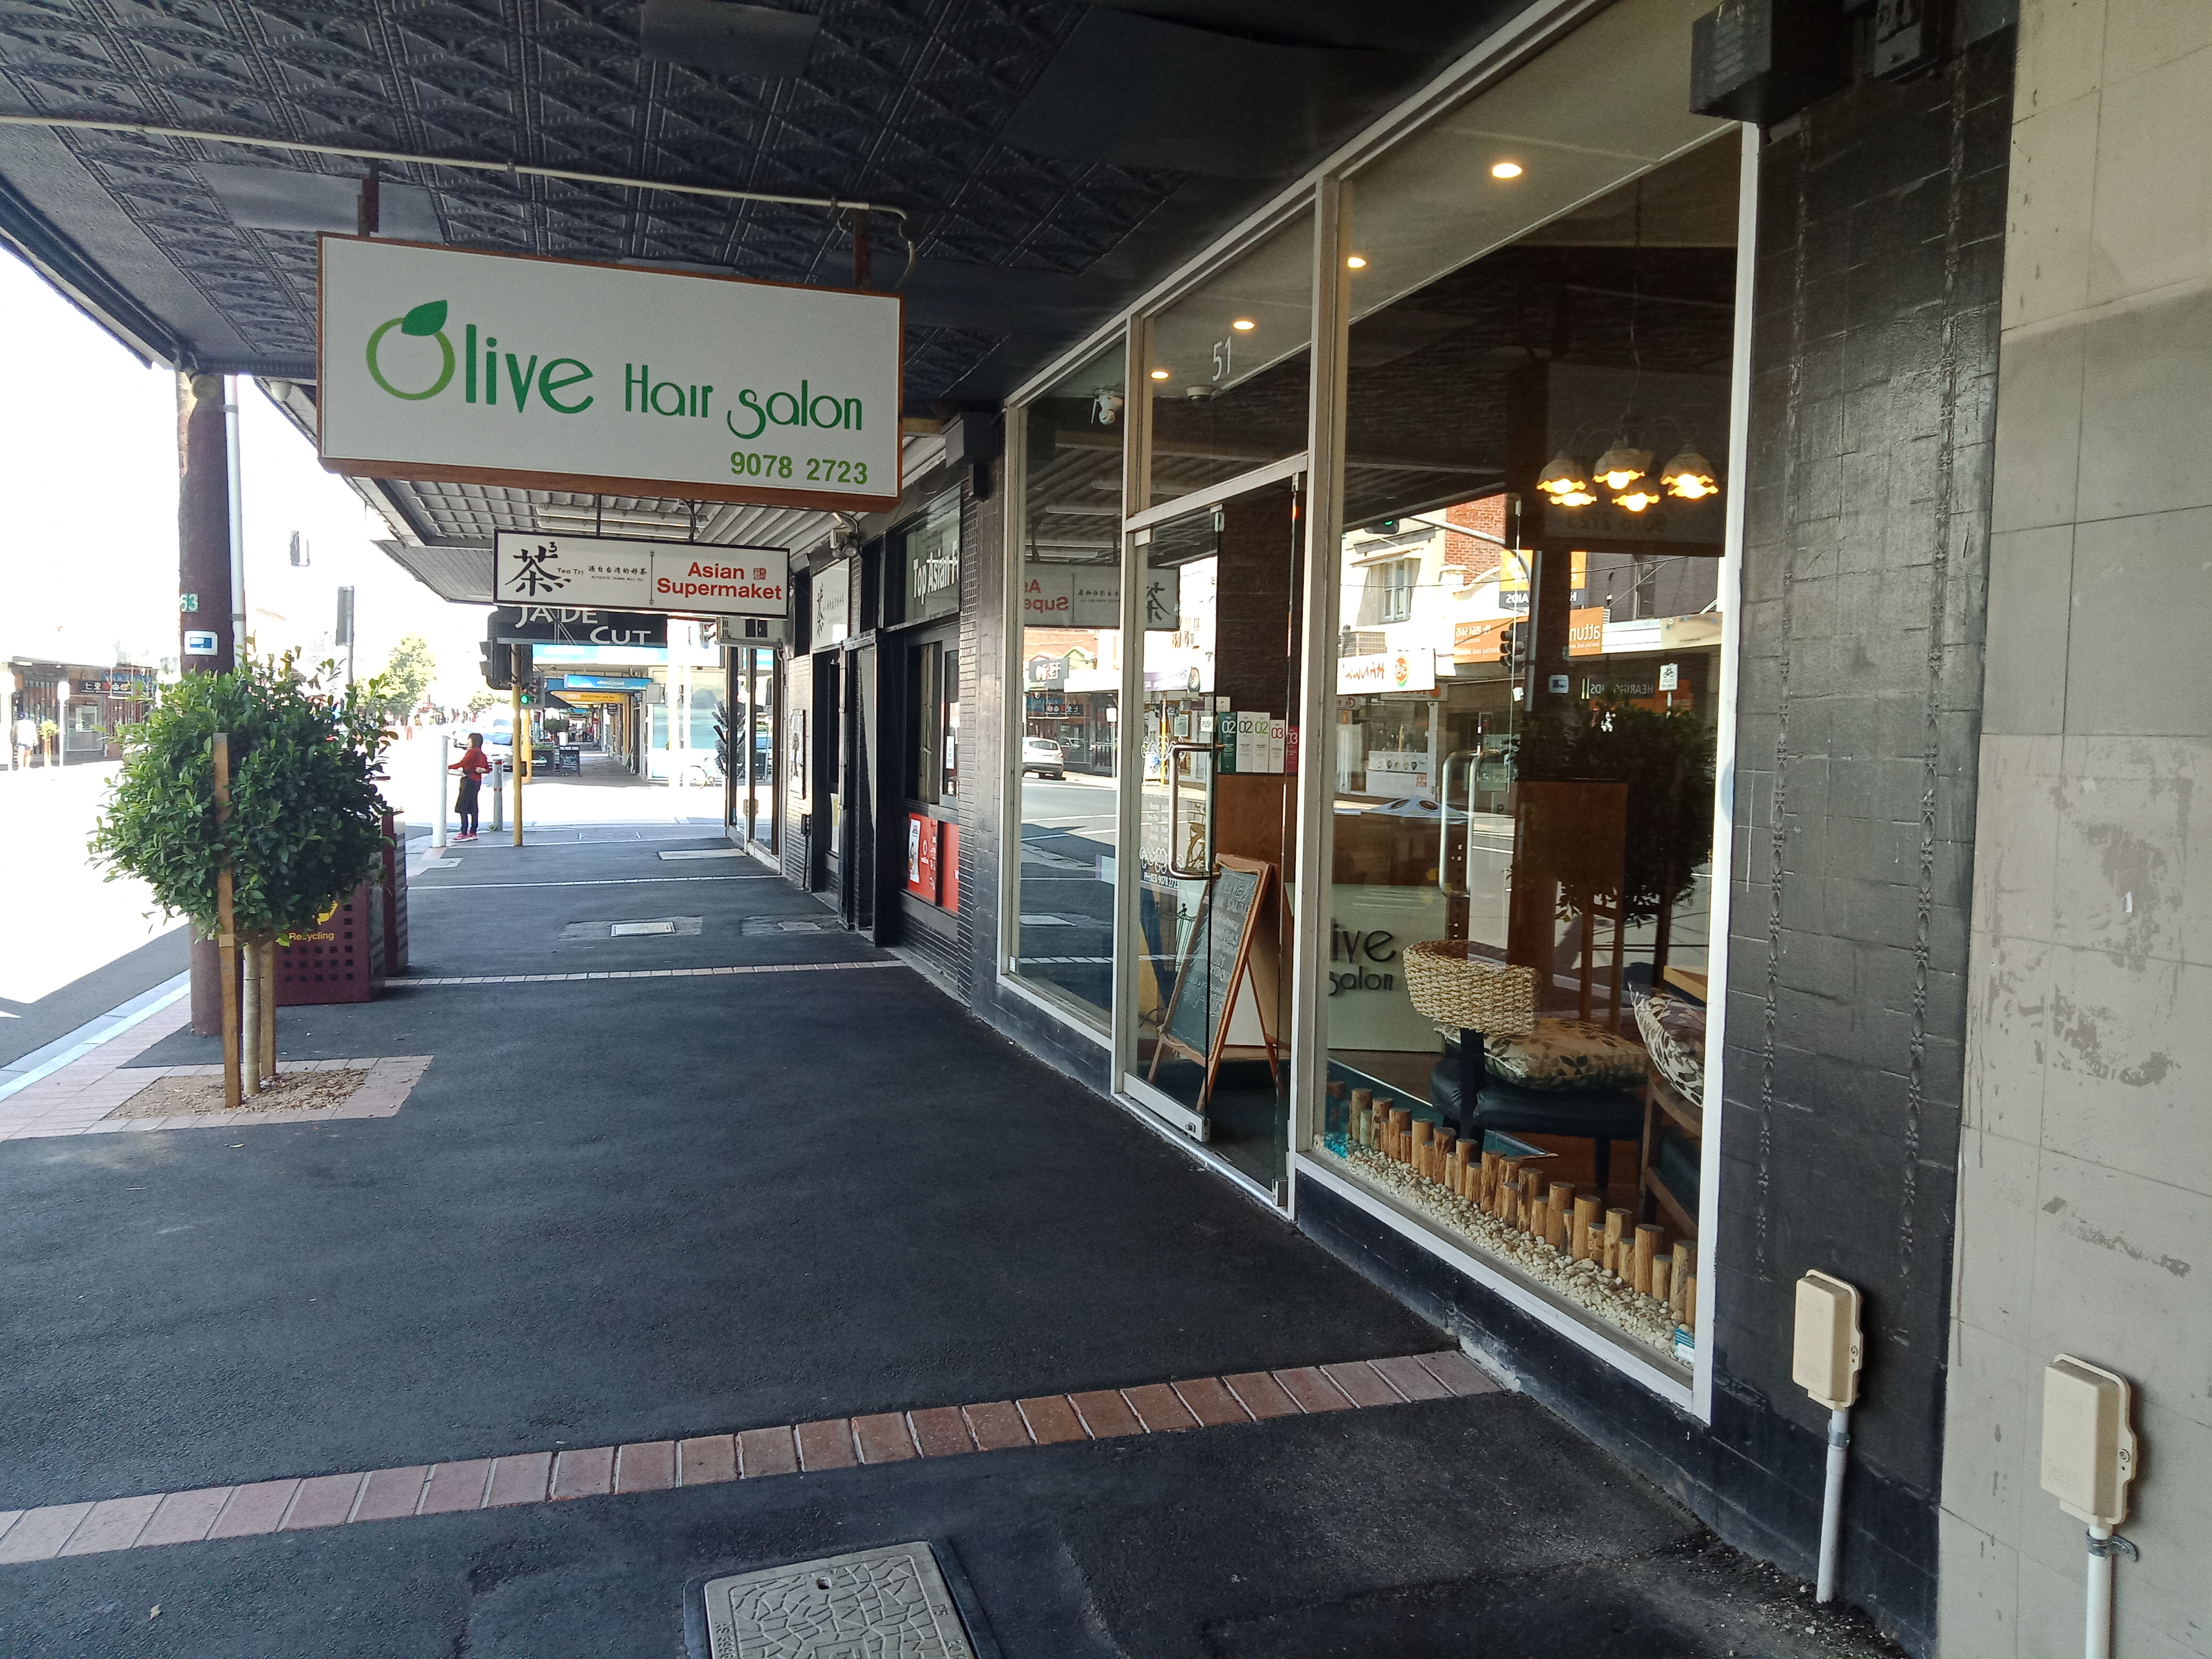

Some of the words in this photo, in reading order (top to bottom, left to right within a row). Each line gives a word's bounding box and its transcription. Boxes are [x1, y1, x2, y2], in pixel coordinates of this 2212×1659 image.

[366, 303, 594, 414] Olive
[626, 363, 714, 418] Hair
[1212, 336, 1231, 381] 51
[731, 451, 792, 479] 9078
[807, 458, 868, 485] 2723
[688, 562, 744, 580] Asian
[913, 558, 927, 605] Top
[927, 548, 950, 593] Asian
[657, 577, 782, 600] Supermaket
[514, 608, 598, 629] JADE
[1222, 720, 1236, 734] 02
[1238, 720, 1253, 733] 02
[1255, 721, 1269, 734] 02
[1271, 727, 1284, 739] 03
